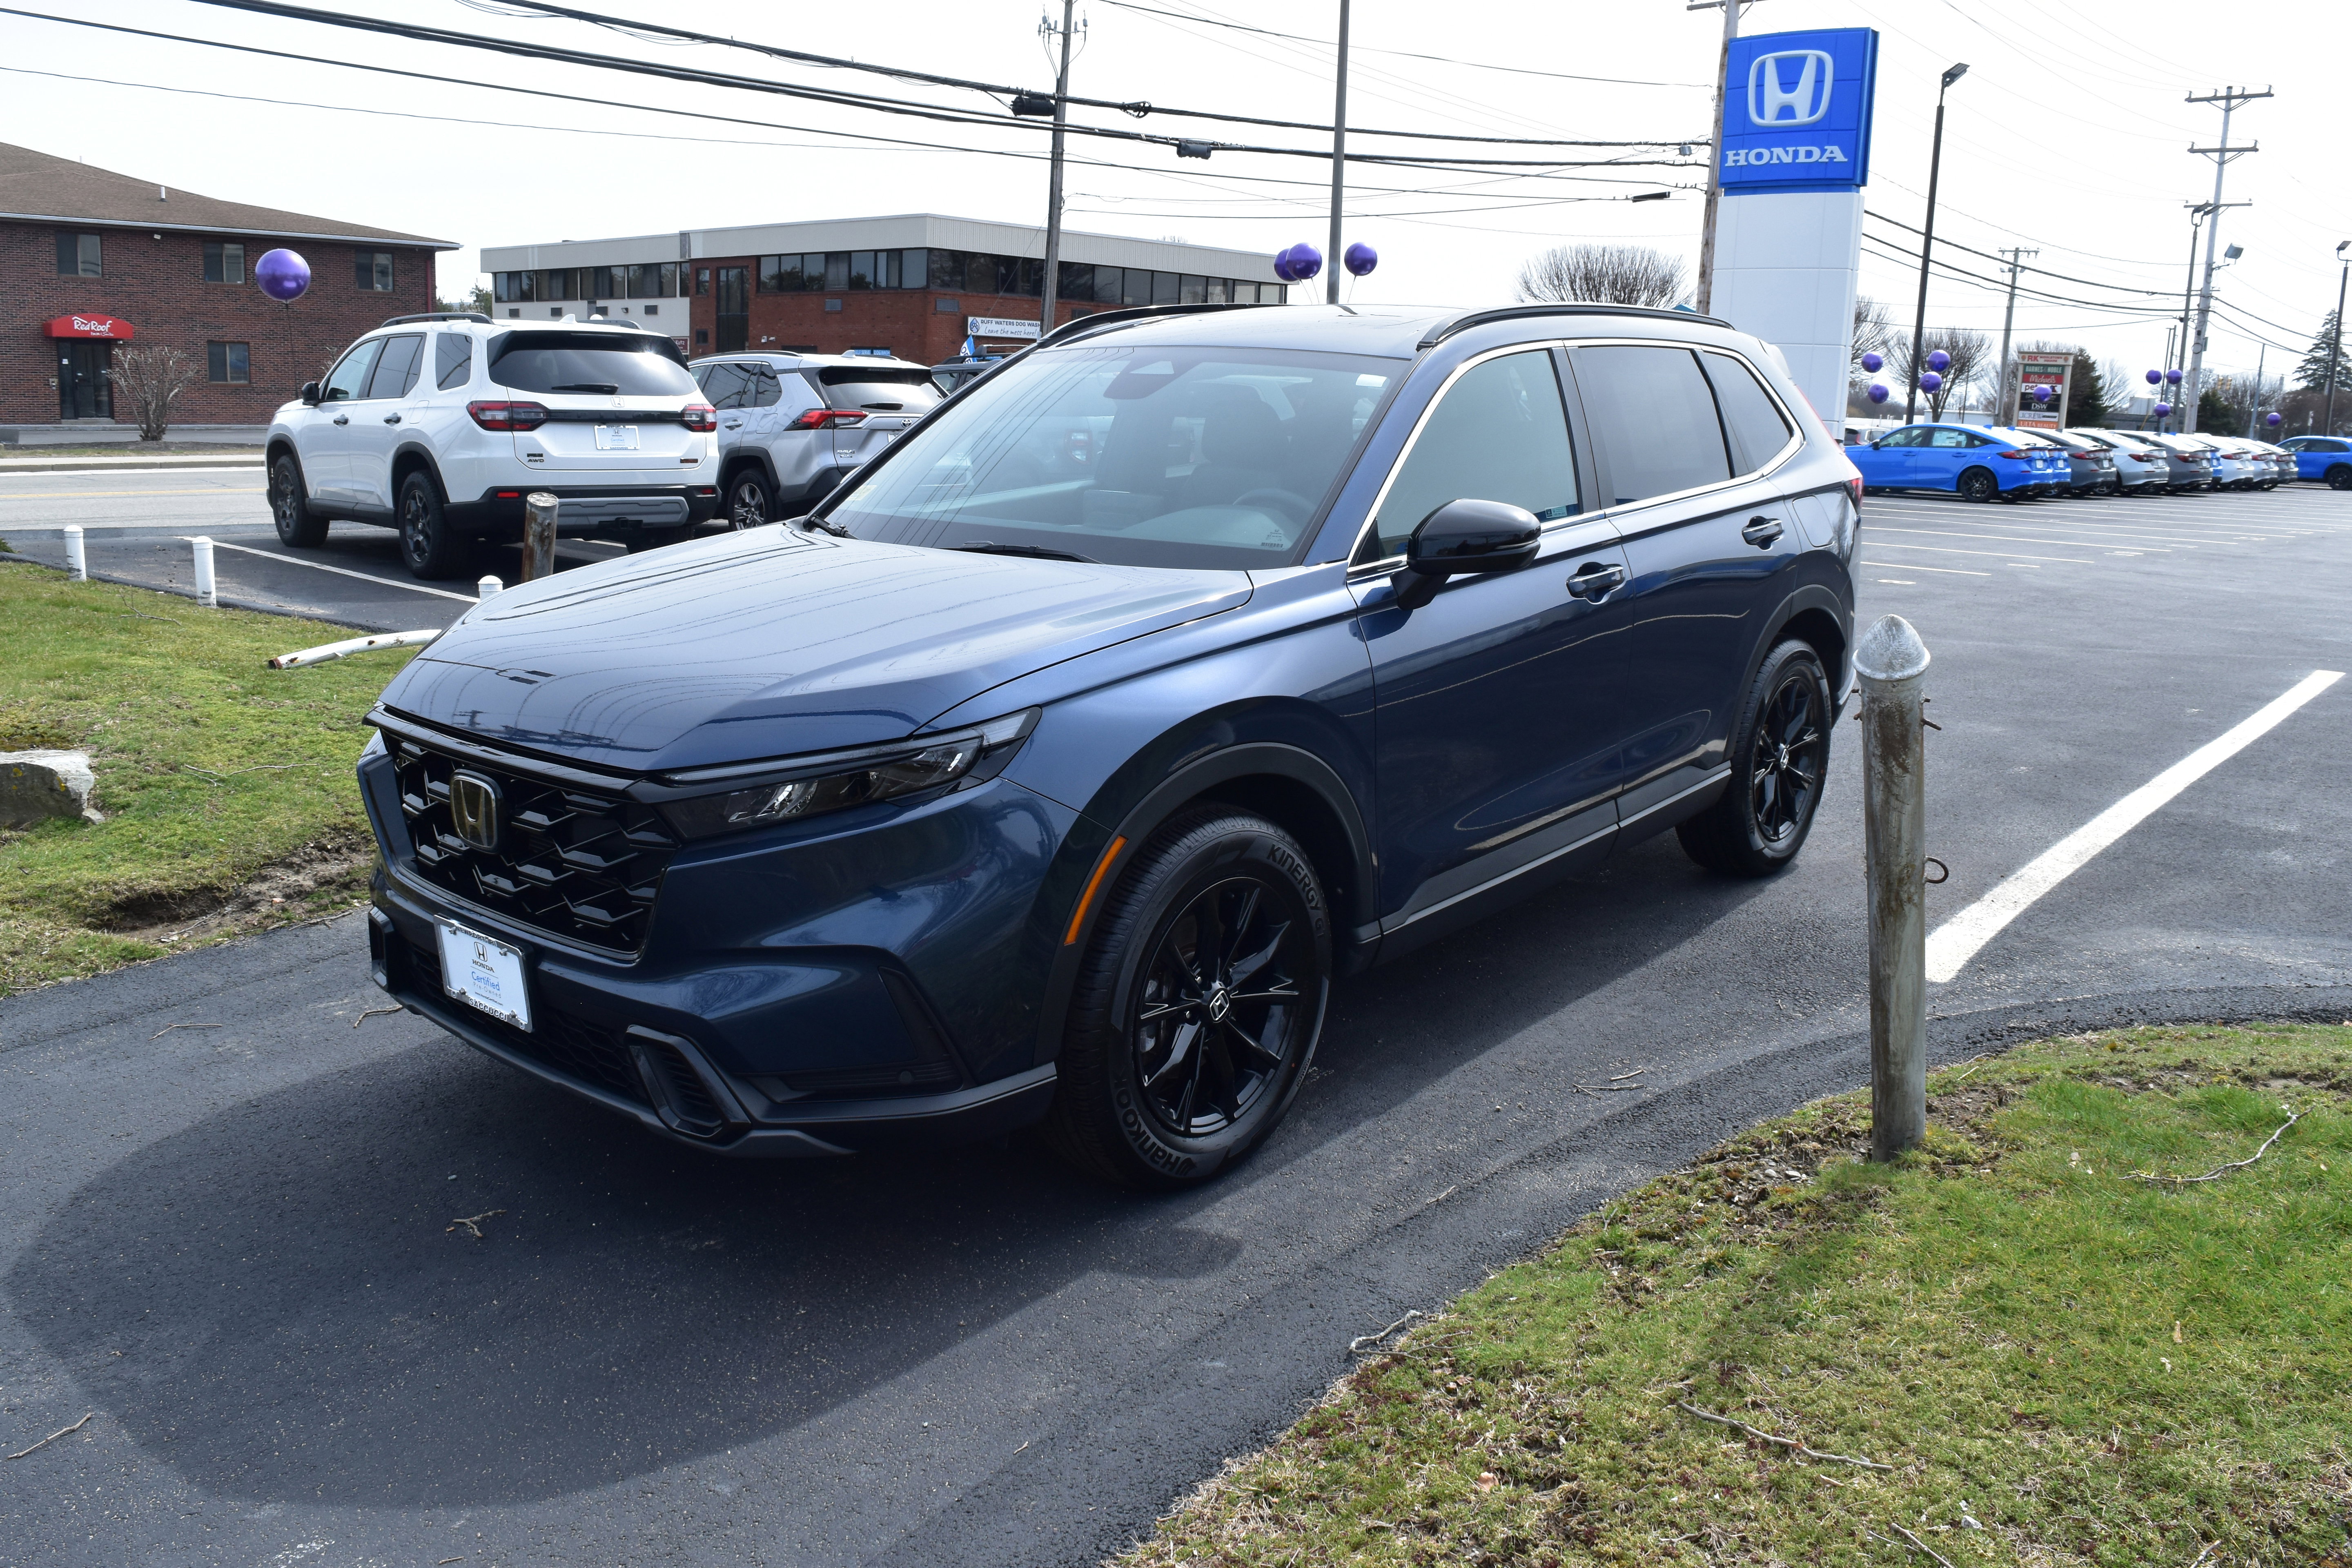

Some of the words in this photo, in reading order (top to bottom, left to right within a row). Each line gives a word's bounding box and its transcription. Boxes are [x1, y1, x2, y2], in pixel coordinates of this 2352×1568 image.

[1725, 145, 1848, 167] HONDA
[472, 959, 494, 973] HONDA
[472, 971, 500, 991] Certified
[469, 998, 507, 1021] SACCUCCI
